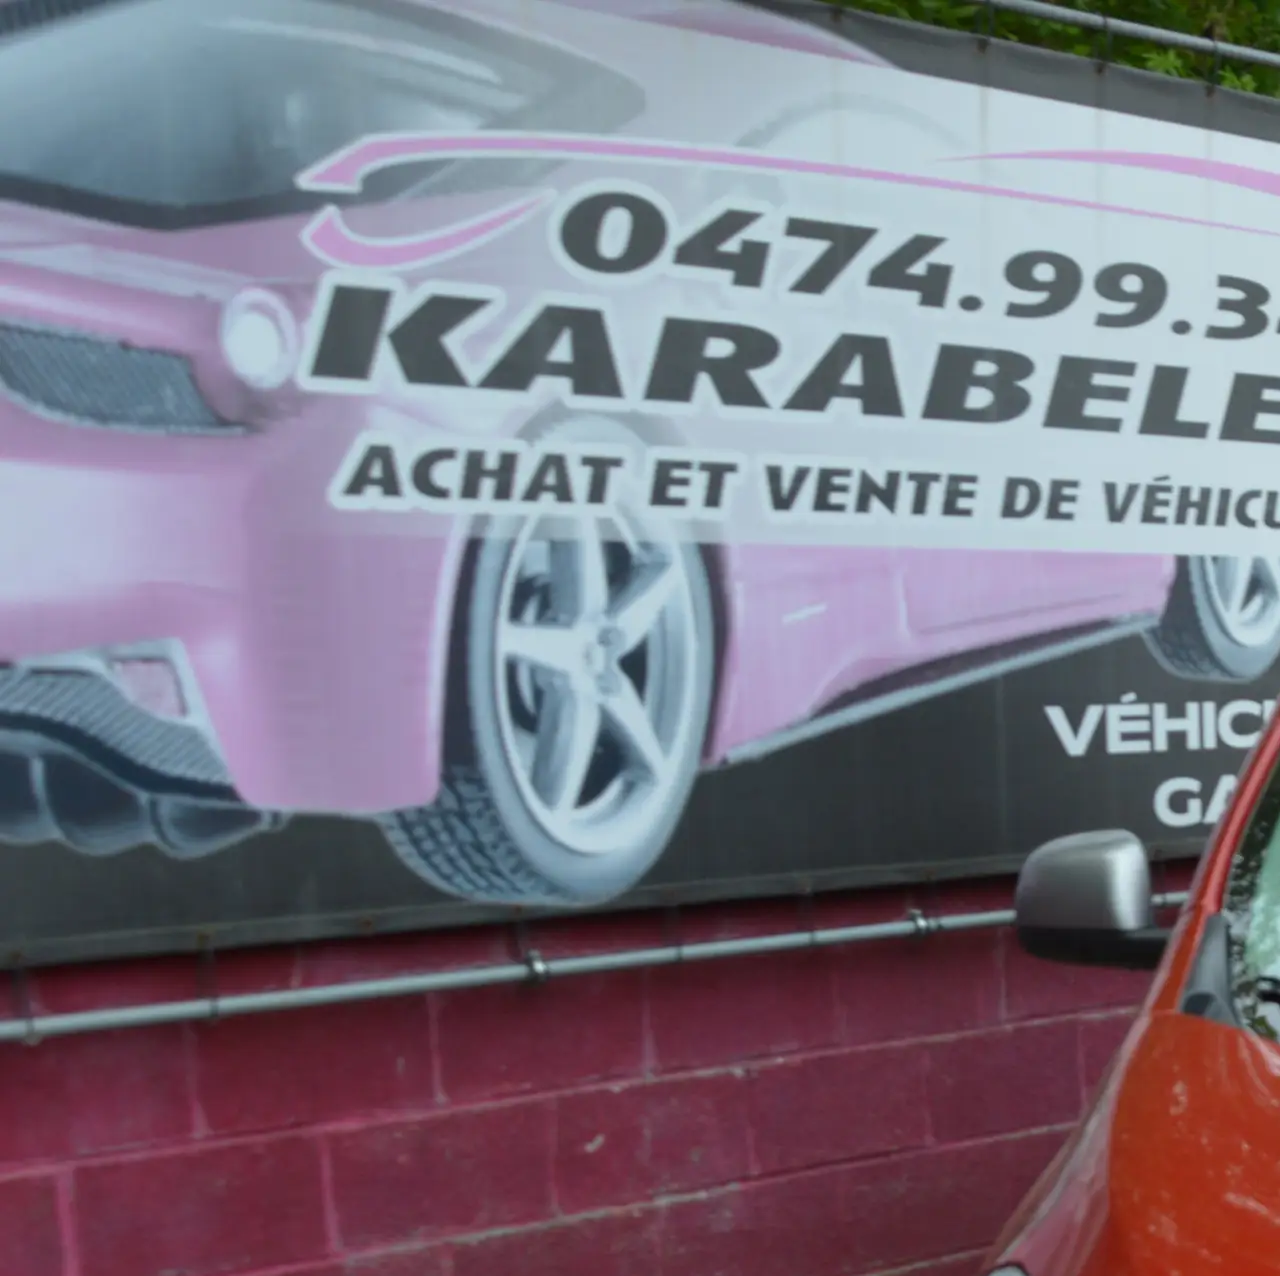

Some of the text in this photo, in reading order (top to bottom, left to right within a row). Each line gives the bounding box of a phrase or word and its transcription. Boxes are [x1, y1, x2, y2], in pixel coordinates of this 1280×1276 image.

[342, 445, 624, 504] ACHAT
[649, 459, 738, 508] ET
[766, 465, 979, 518] VENTE
[1000, 477, 1080, 521] DE
[1044, 692, 1278, 757] VÉHIC
